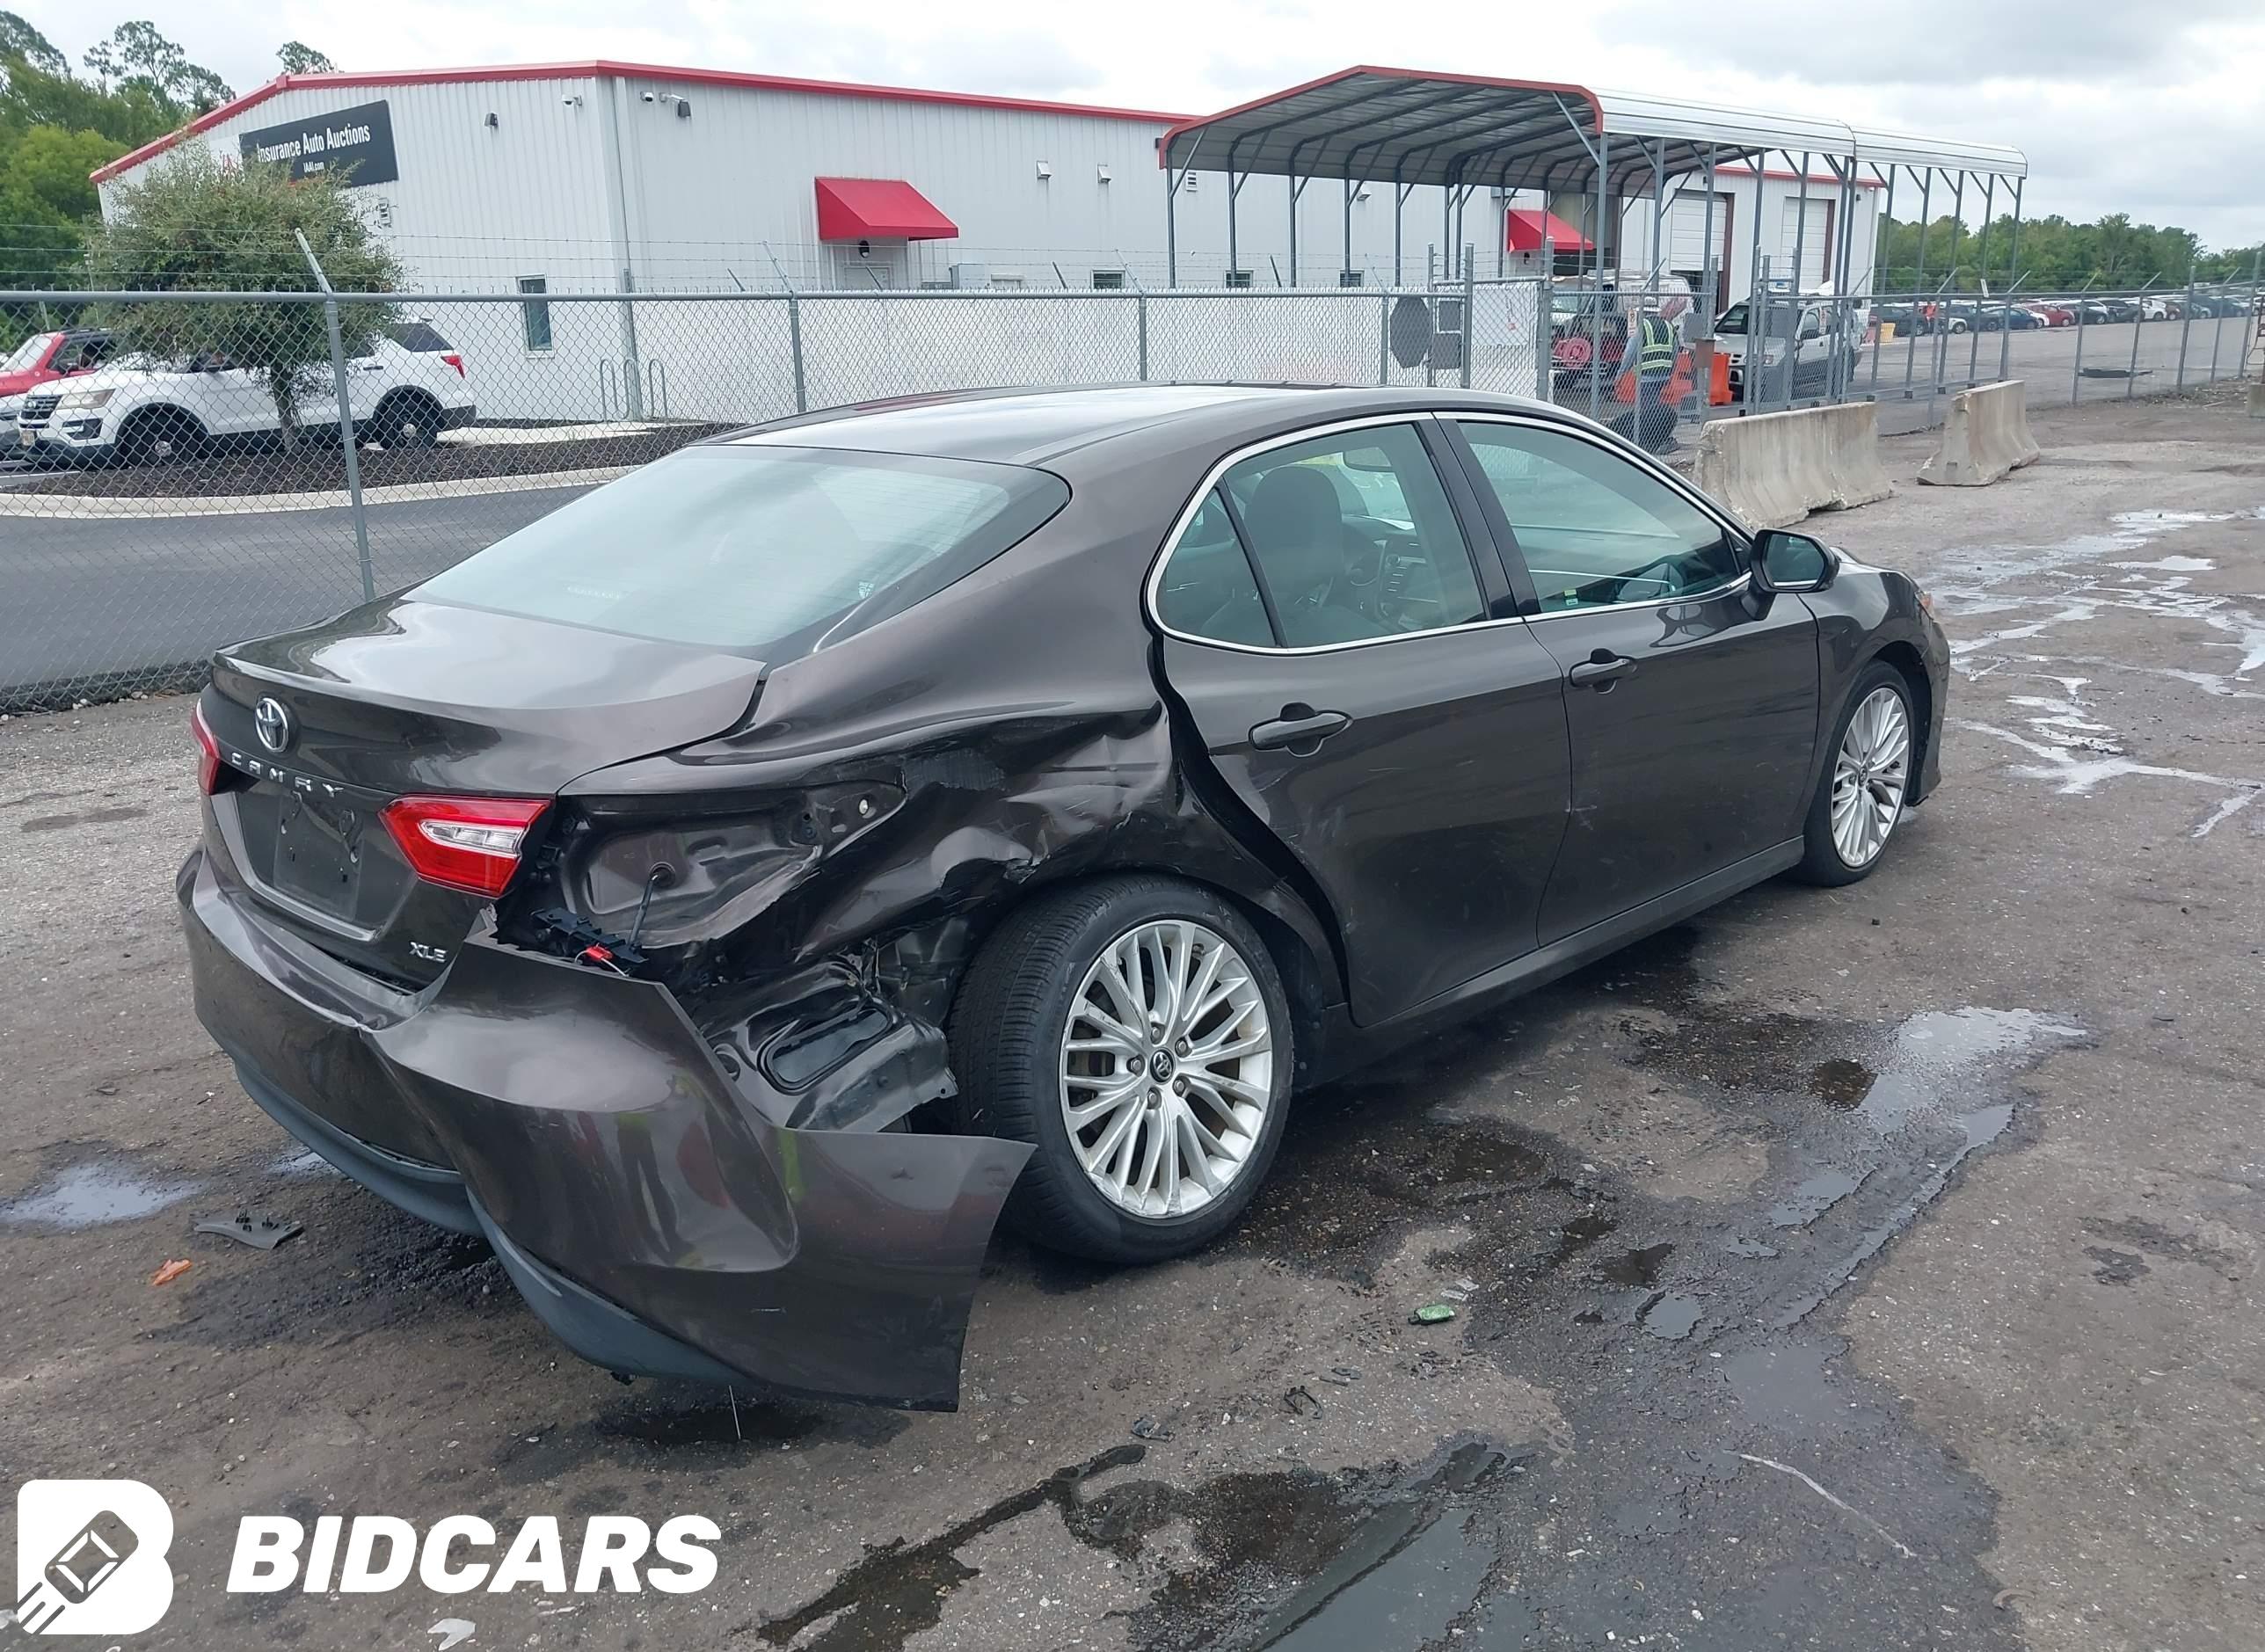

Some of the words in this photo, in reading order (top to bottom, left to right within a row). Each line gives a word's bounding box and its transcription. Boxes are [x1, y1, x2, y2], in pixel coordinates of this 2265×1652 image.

[256, 140, 302, 164] Insurance
[302, 132, 325, 155] Auto
[326, 122, 371, 150] Auctions
[231, 752, 345, 798] CAMRY
[409, 942, 448, 964] XLE
